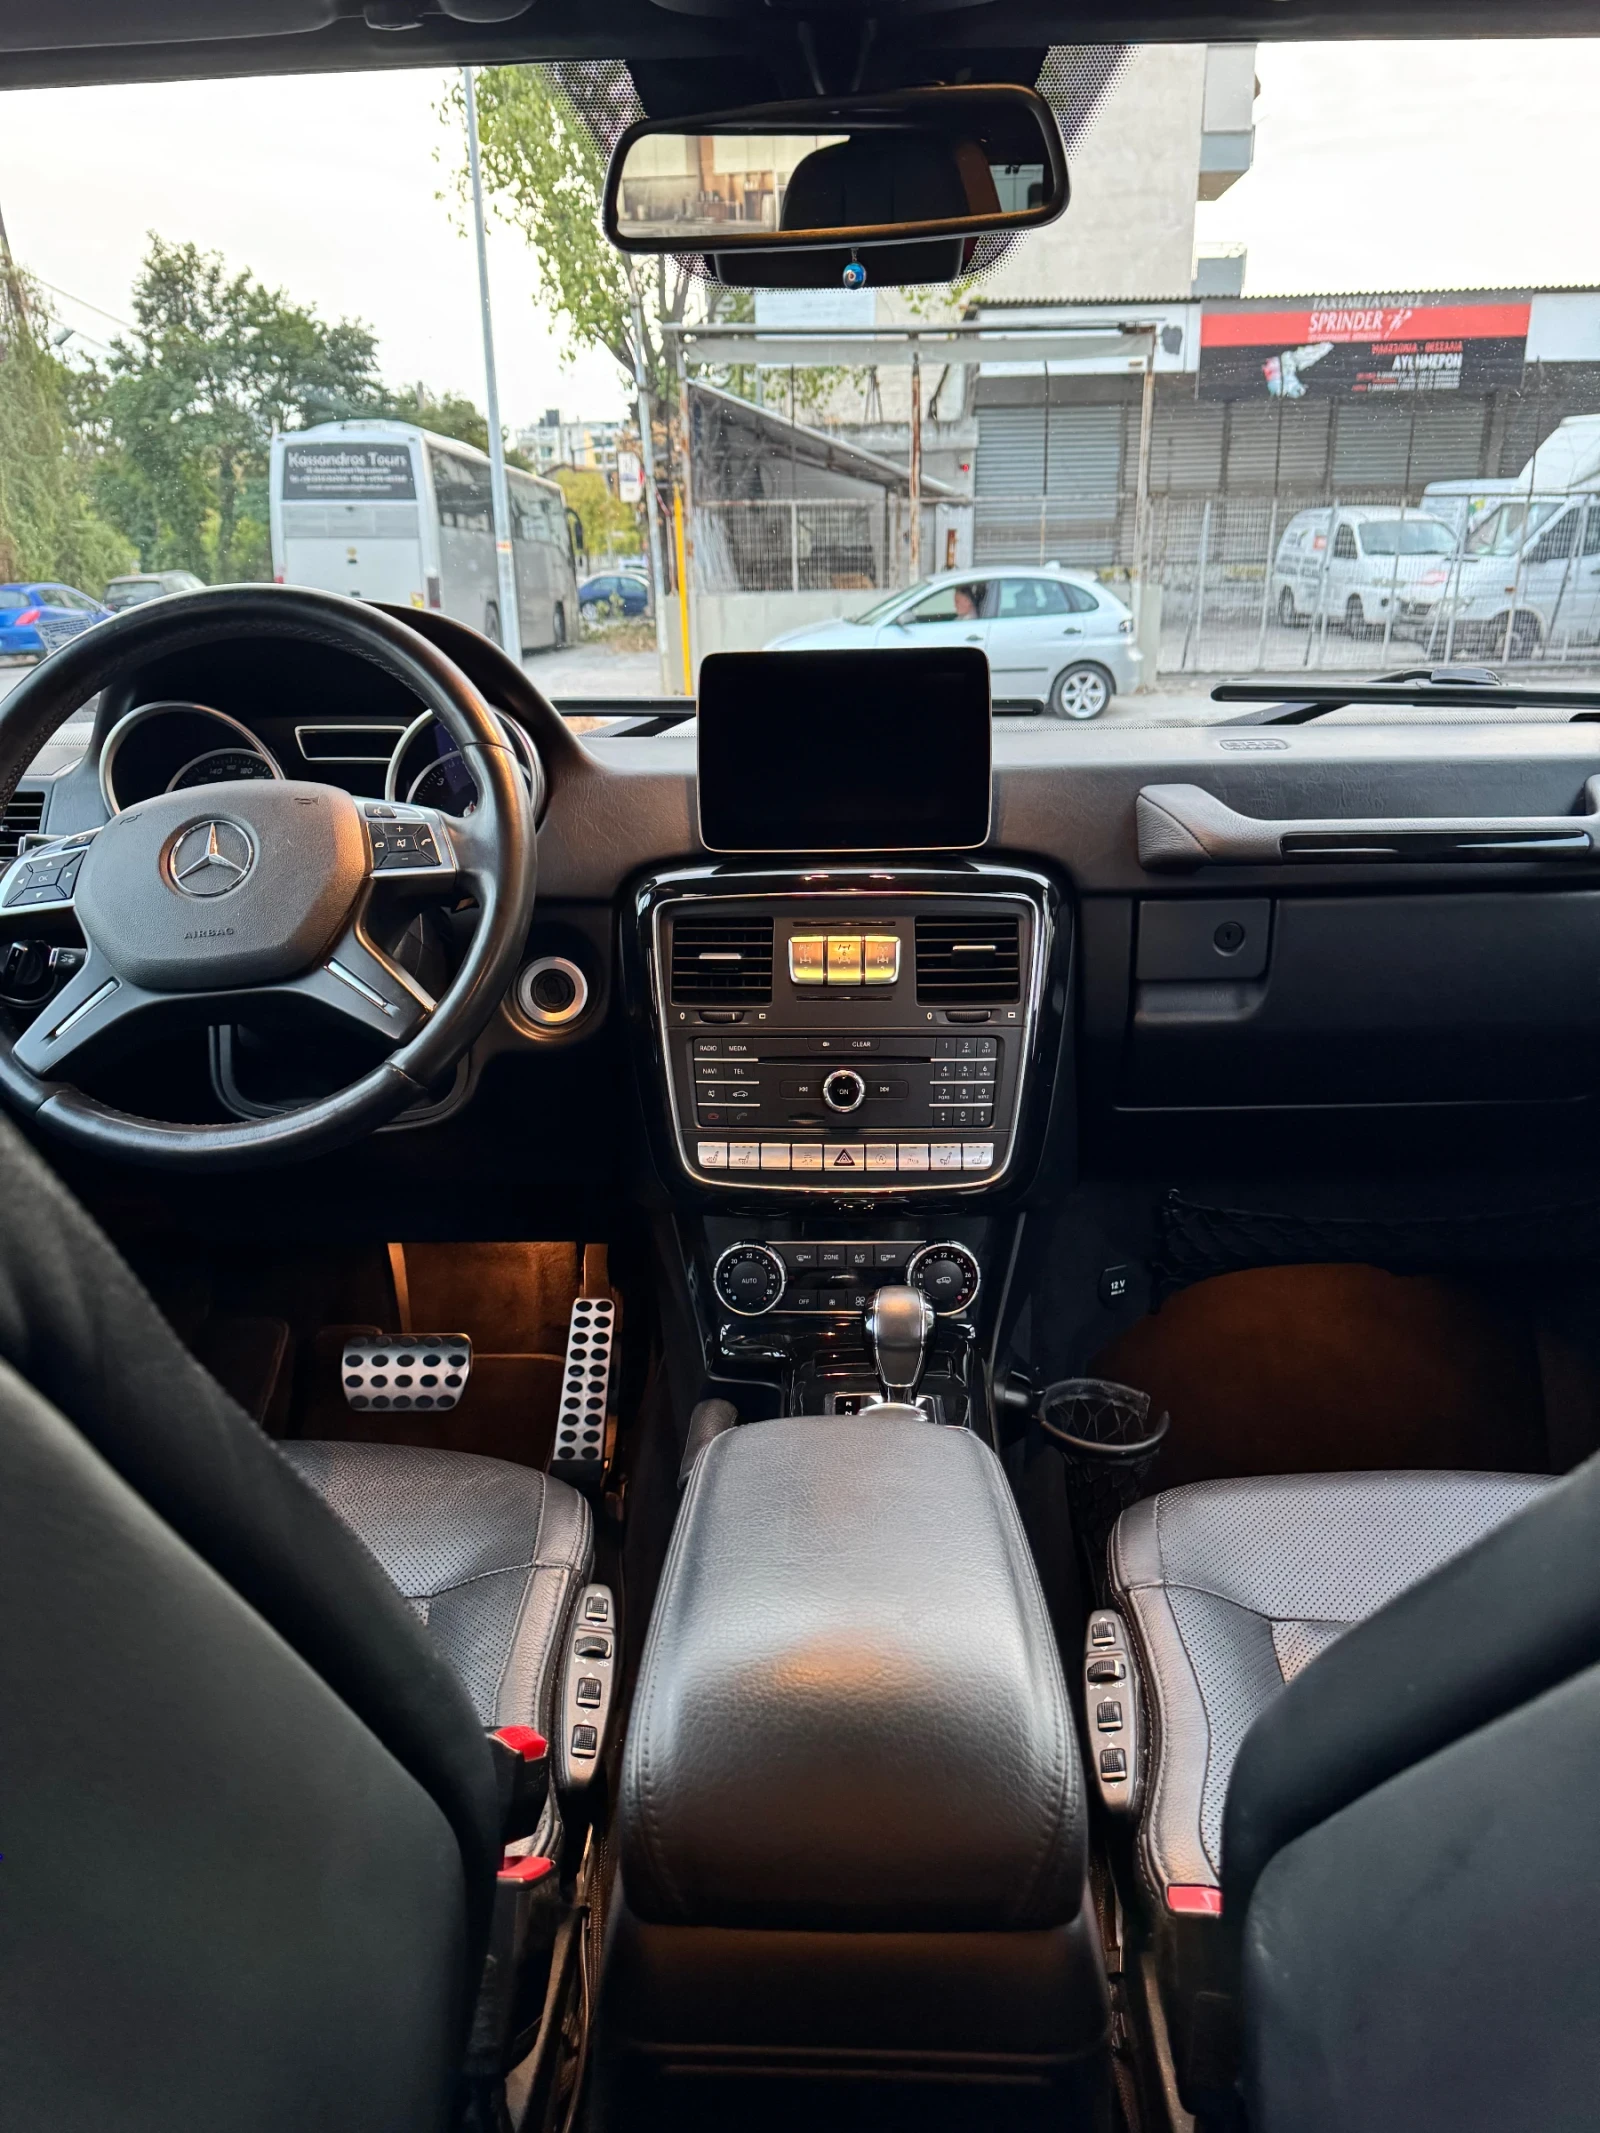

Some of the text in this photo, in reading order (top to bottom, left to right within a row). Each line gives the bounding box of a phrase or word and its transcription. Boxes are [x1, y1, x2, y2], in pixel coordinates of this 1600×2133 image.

[1308, 310, 1383, 333] SPRINDER
[367, 451, 407, 467] Tours
[38, 875, 48, 883] OK
[184, 927, 235, 940] AIRBAG
